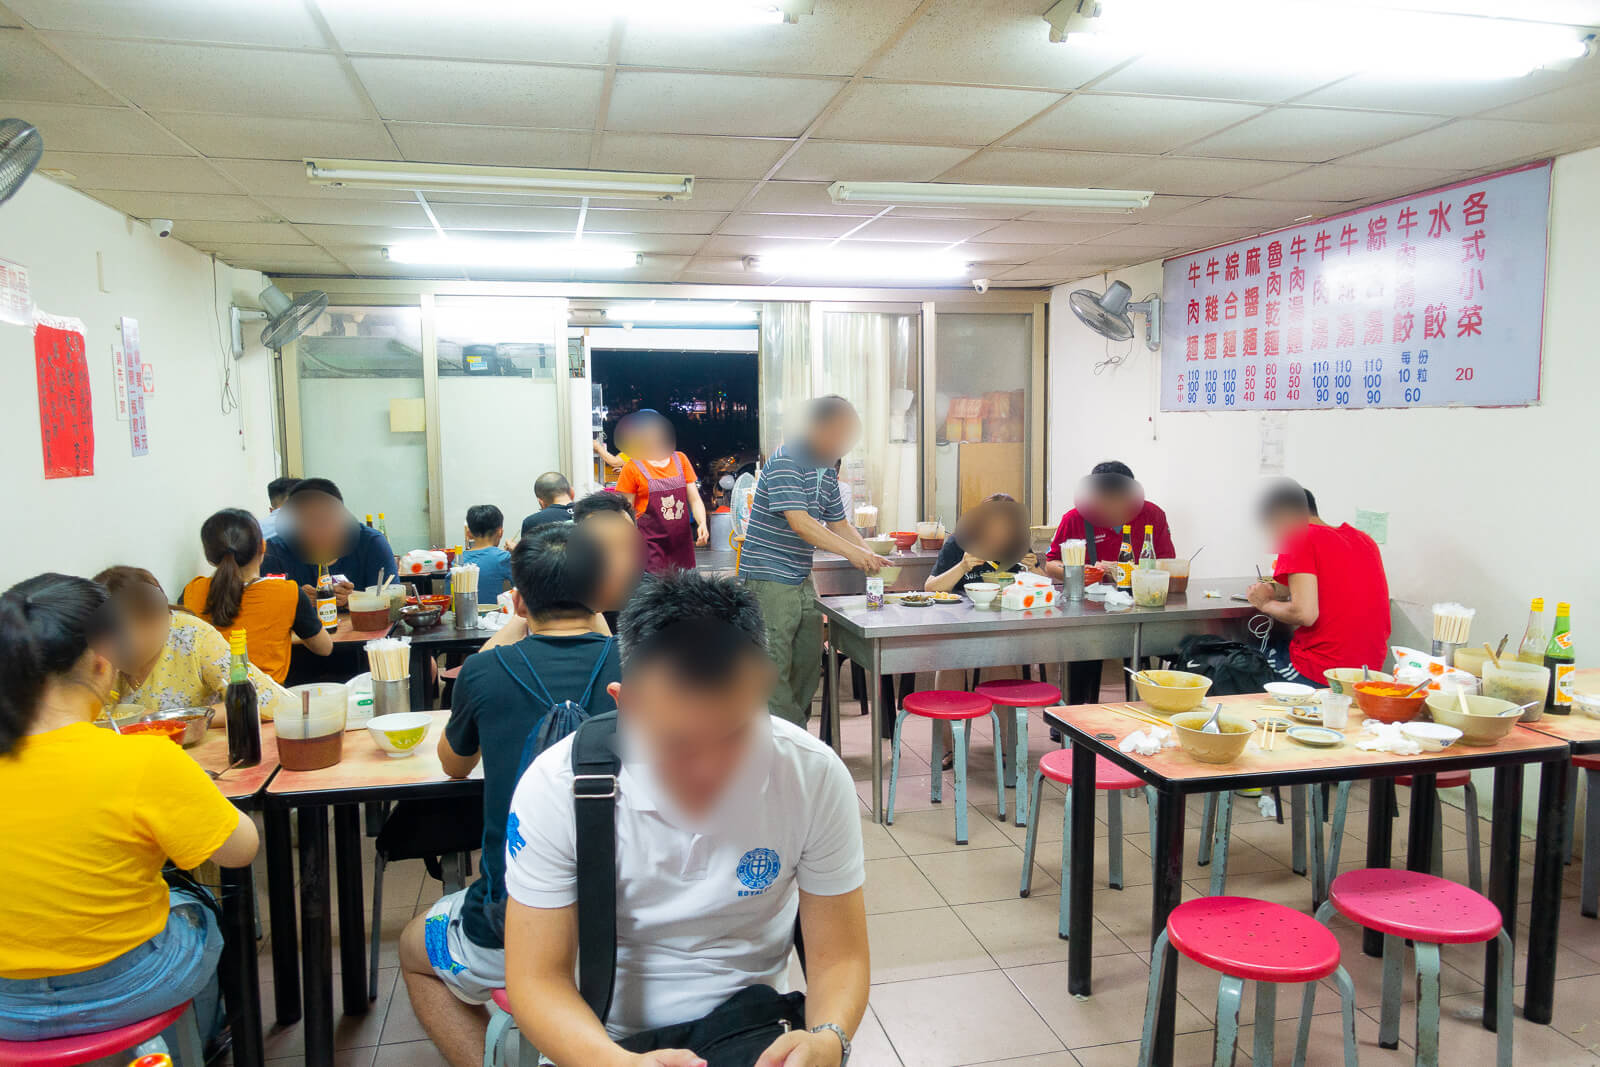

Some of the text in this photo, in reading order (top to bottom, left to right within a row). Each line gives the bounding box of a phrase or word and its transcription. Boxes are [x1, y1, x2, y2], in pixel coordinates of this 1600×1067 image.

[1457, 191, 1488, 338] 各式小菜
[1243, 246, 1262, 357] 麻醬麵
[1264, 240, 1283, 357] 魯肉乾麵
[1186, 260, 1201, 362] 牛肉麵
[1223, 251, 1240, 359] 綜合麵
[1245, 365, 1257, 377] 60
[1266, 363, 1277, 375] 60
[1289, 362, 1301, 375] 60
[1313, 360, 1329, 374] 110
[1335, 359, 1352, 373] 110
[1365, 358, 1383, 372] 110
[1188, 369, 1200, 380] 110
[1205, 369, 1218, 380] 110
[1223, 369, 1237, 380] 110
[1456, 367, 1474, 381] 20
[1187, 381, 1199, 392] 100
[1205, 381, 1217, 392] 100
[1223, 381, 1236, 392] 100
[1244, 378, 1255, 390] 50
[1265, 377, 1276, 389] 50
[1288, 376, 1300, 388] 50
[1313, 375, 1329, 388] 100
[1335, 374, 1351, 388] 100
[1363, 374, 1382, 388] 100
[1188, 392, 1197, 403] 90
[1207, 393, 1216, 404] 90
[1225, 394, 1235, 405] 90
[1243, 391, 1255, 402] 40
[1264, 390, 1276, 401] 40
[1287, 389, 1300, 401] 40
[1316, 389, 1329, 401] 90
[1336, 391, 1349, 404] 90
[1367, 390, 1381, 404] 90
[1405, 387, 1421, 402] 60
